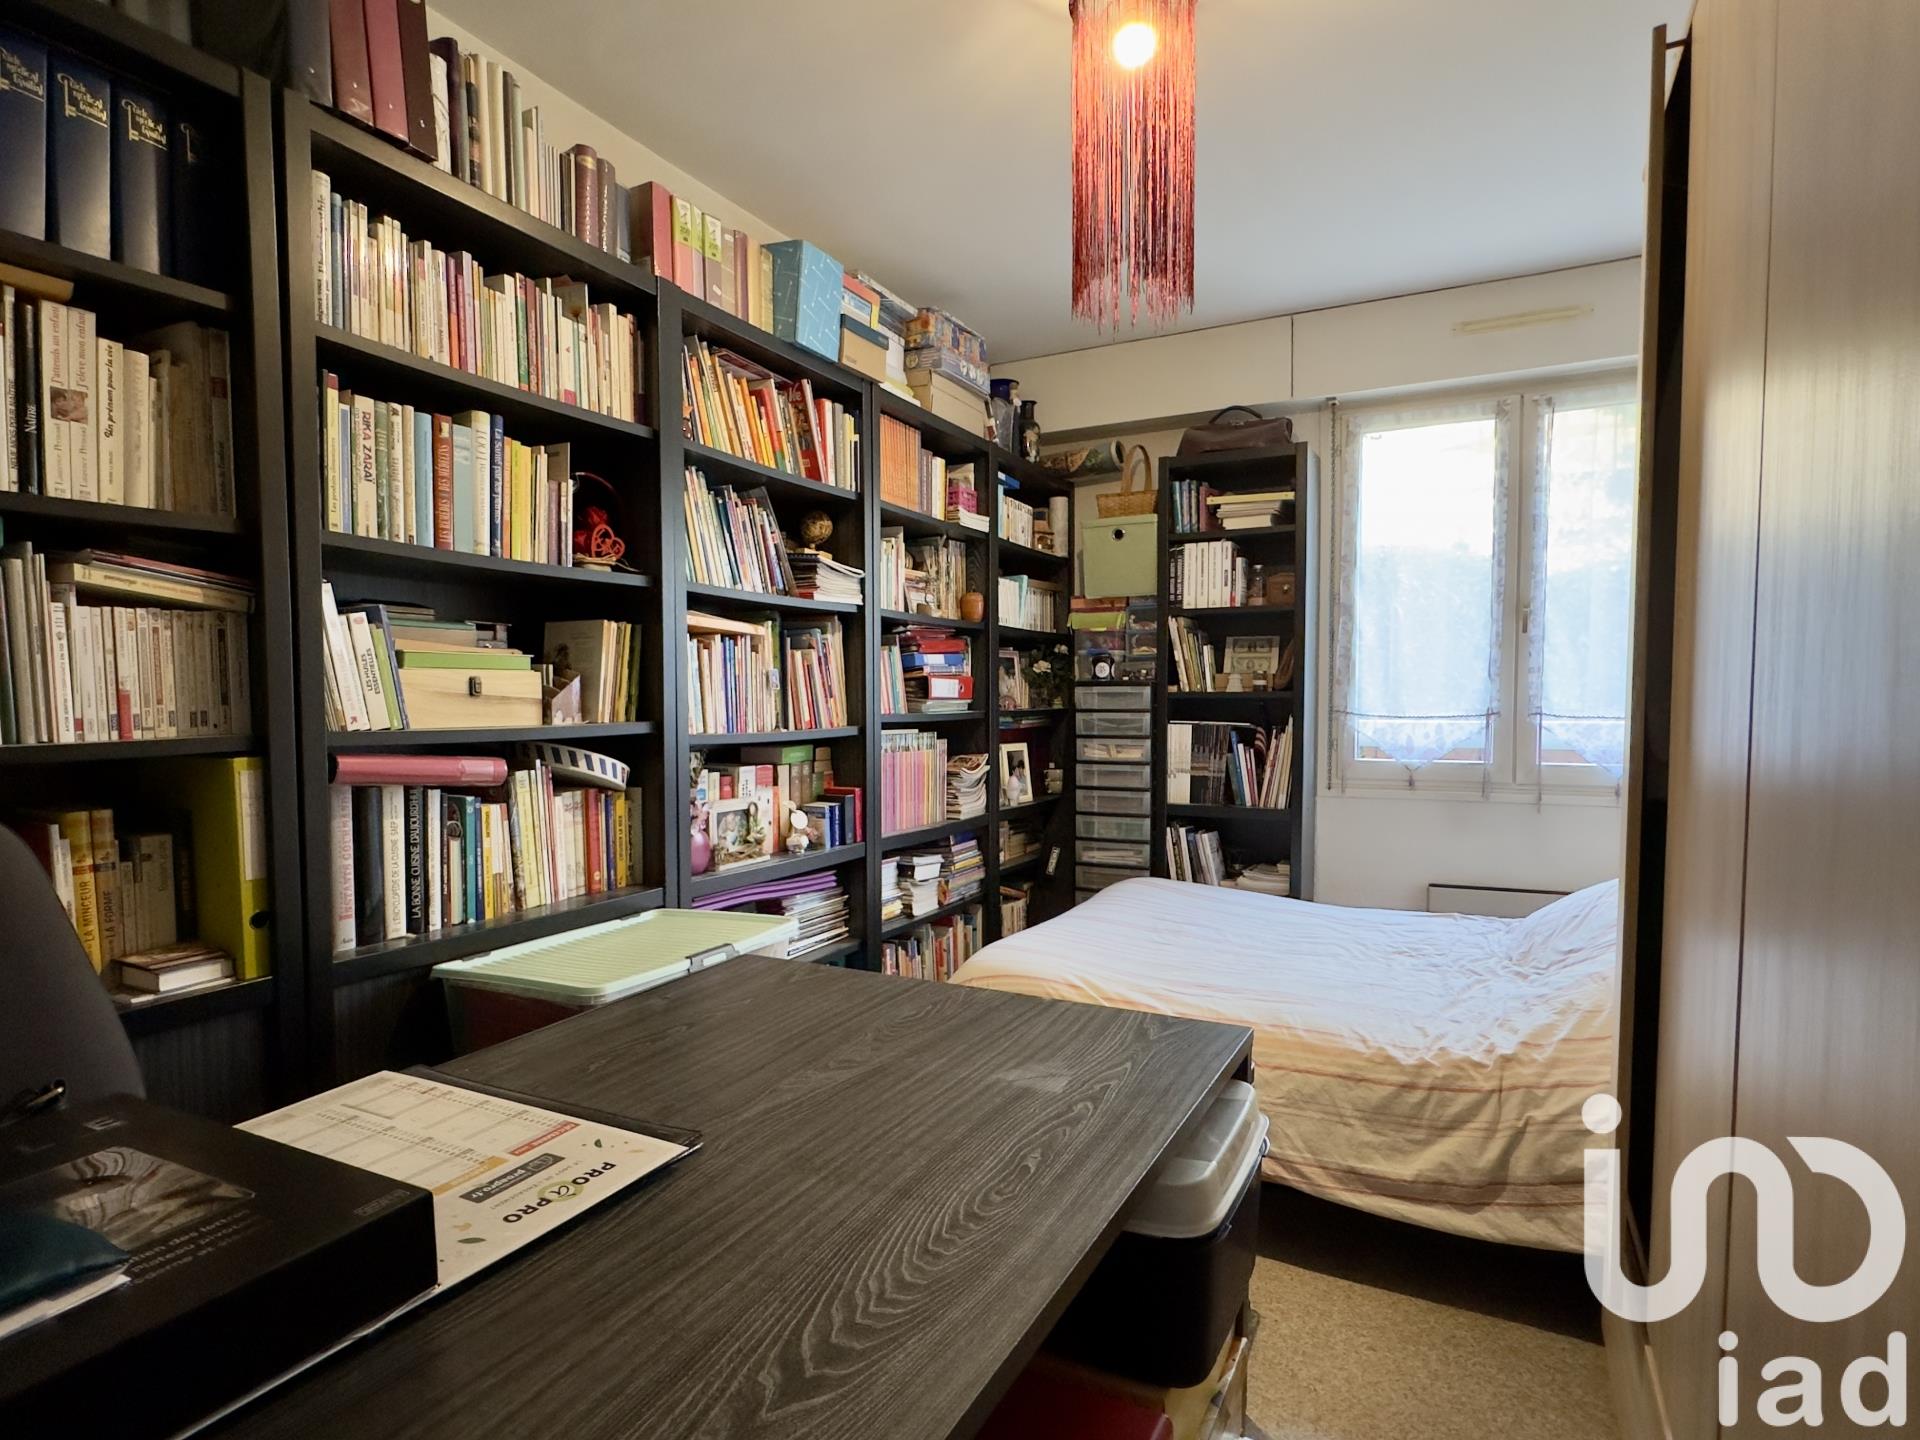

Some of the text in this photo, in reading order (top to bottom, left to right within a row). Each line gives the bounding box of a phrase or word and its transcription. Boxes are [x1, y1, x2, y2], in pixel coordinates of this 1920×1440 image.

[361, 411, 376, 485] RIKA ZARAÏ
[494, 427, 503, 440] La
[494, 440, 503, 464] Santé
[492, 465, 502, 480] par
[435, 443, 451, 544] LES REMÈDES DES MÉDECINS
[493, 481, 502, 494] les
[360, 653, 374, 692] LES HUILES
[366, 647, 381, 695] ESSENTIELLES
[409, 845, 421, 876] CUISINE
[409, 877, 421, 906] BONNE
[78, 880, 96, 943] LA MINCEUR
[102, 889, 117, 939] LA FORME
[409, 905, 421, 919] LA
[570, 1162, 617, 1186] PRO
[502, 1197, 553, 1224] PRO
